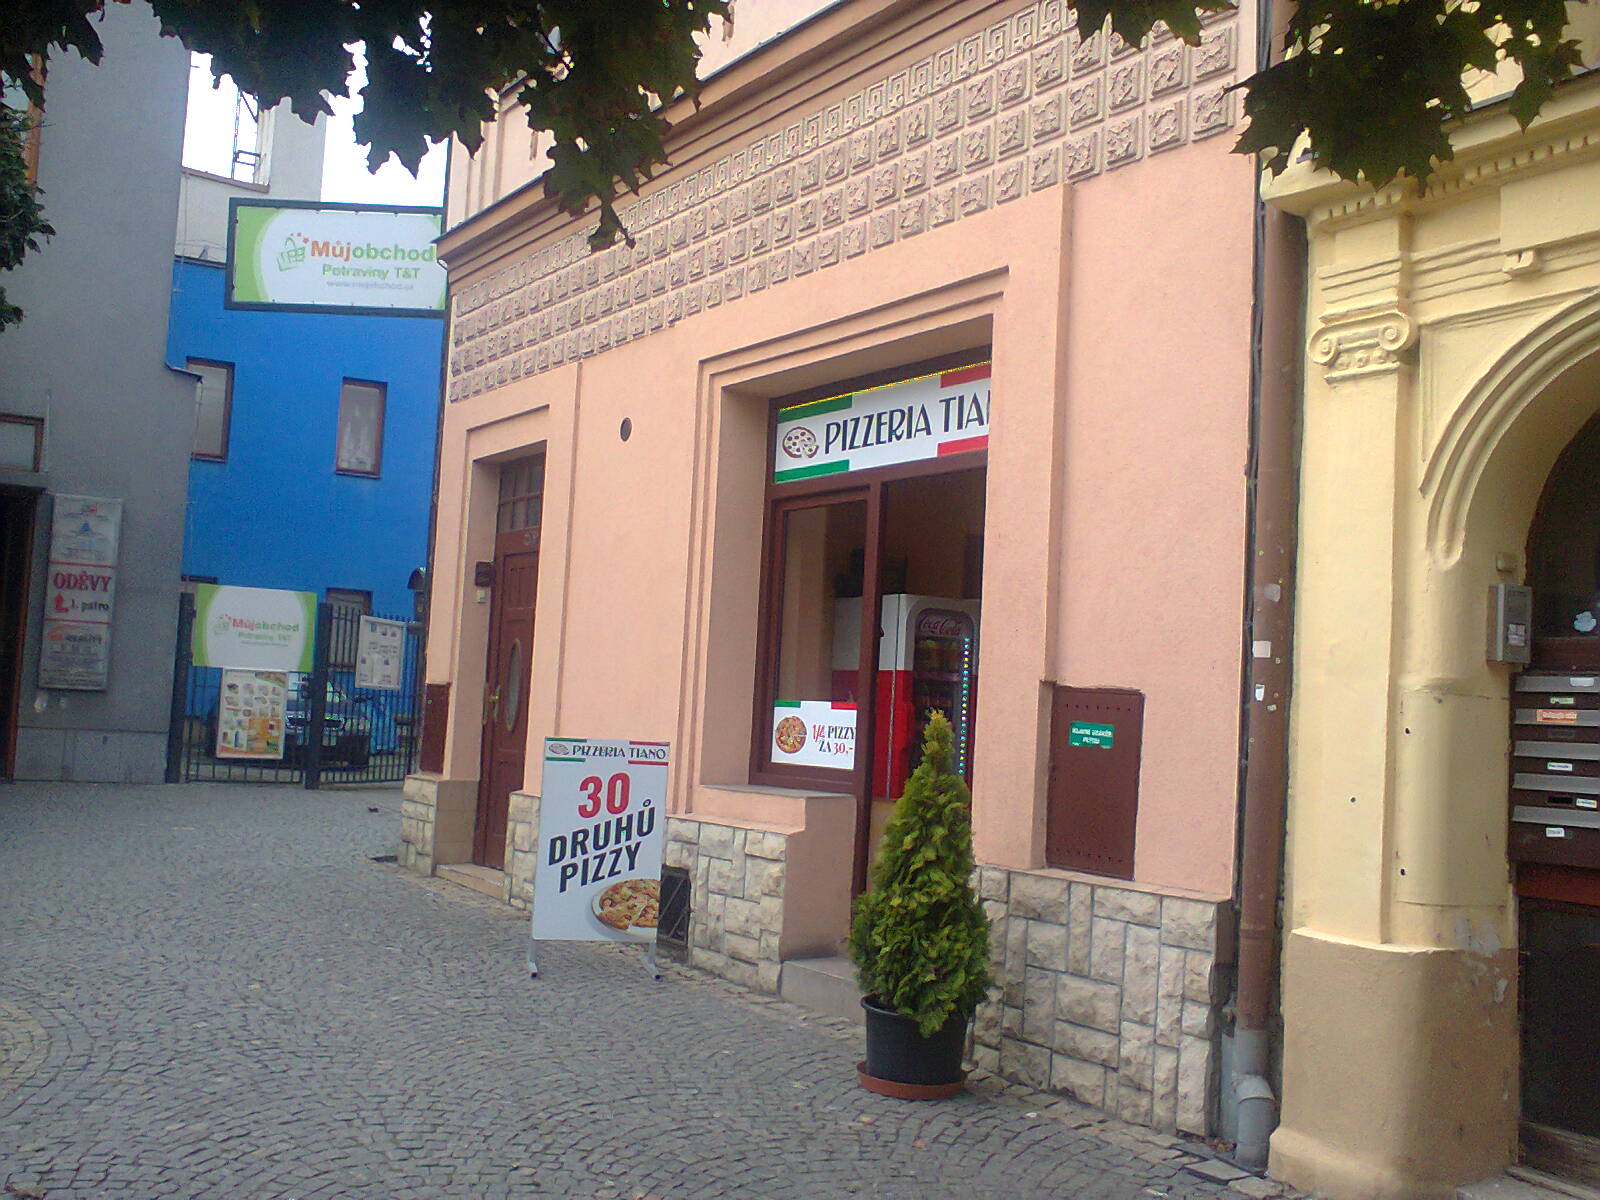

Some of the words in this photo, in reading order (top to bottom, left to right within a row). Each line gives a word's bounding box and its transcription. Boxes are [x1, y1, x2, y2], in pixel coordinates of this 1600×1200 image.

[311, 240, 436, 262] Můjobchod
[322, 263, 389, 281] Potraviny
[395, 266, 420, 280] T&T
[824, 403, 932, 454] PIZZERIA
[53, 571, 112, 592] ODĚVY
[828, 725, 856, 740] PIZZY
[572, 744, 625, 757] PIZZERIA
[629, 747, 667, 760] TIANO
[819, 740, 831, 752] ZA
[578, 772, 630, 818] 30
[548, 798, 655, 866] DRUHŮ
[559, 841, 642, 893] PIZZY
